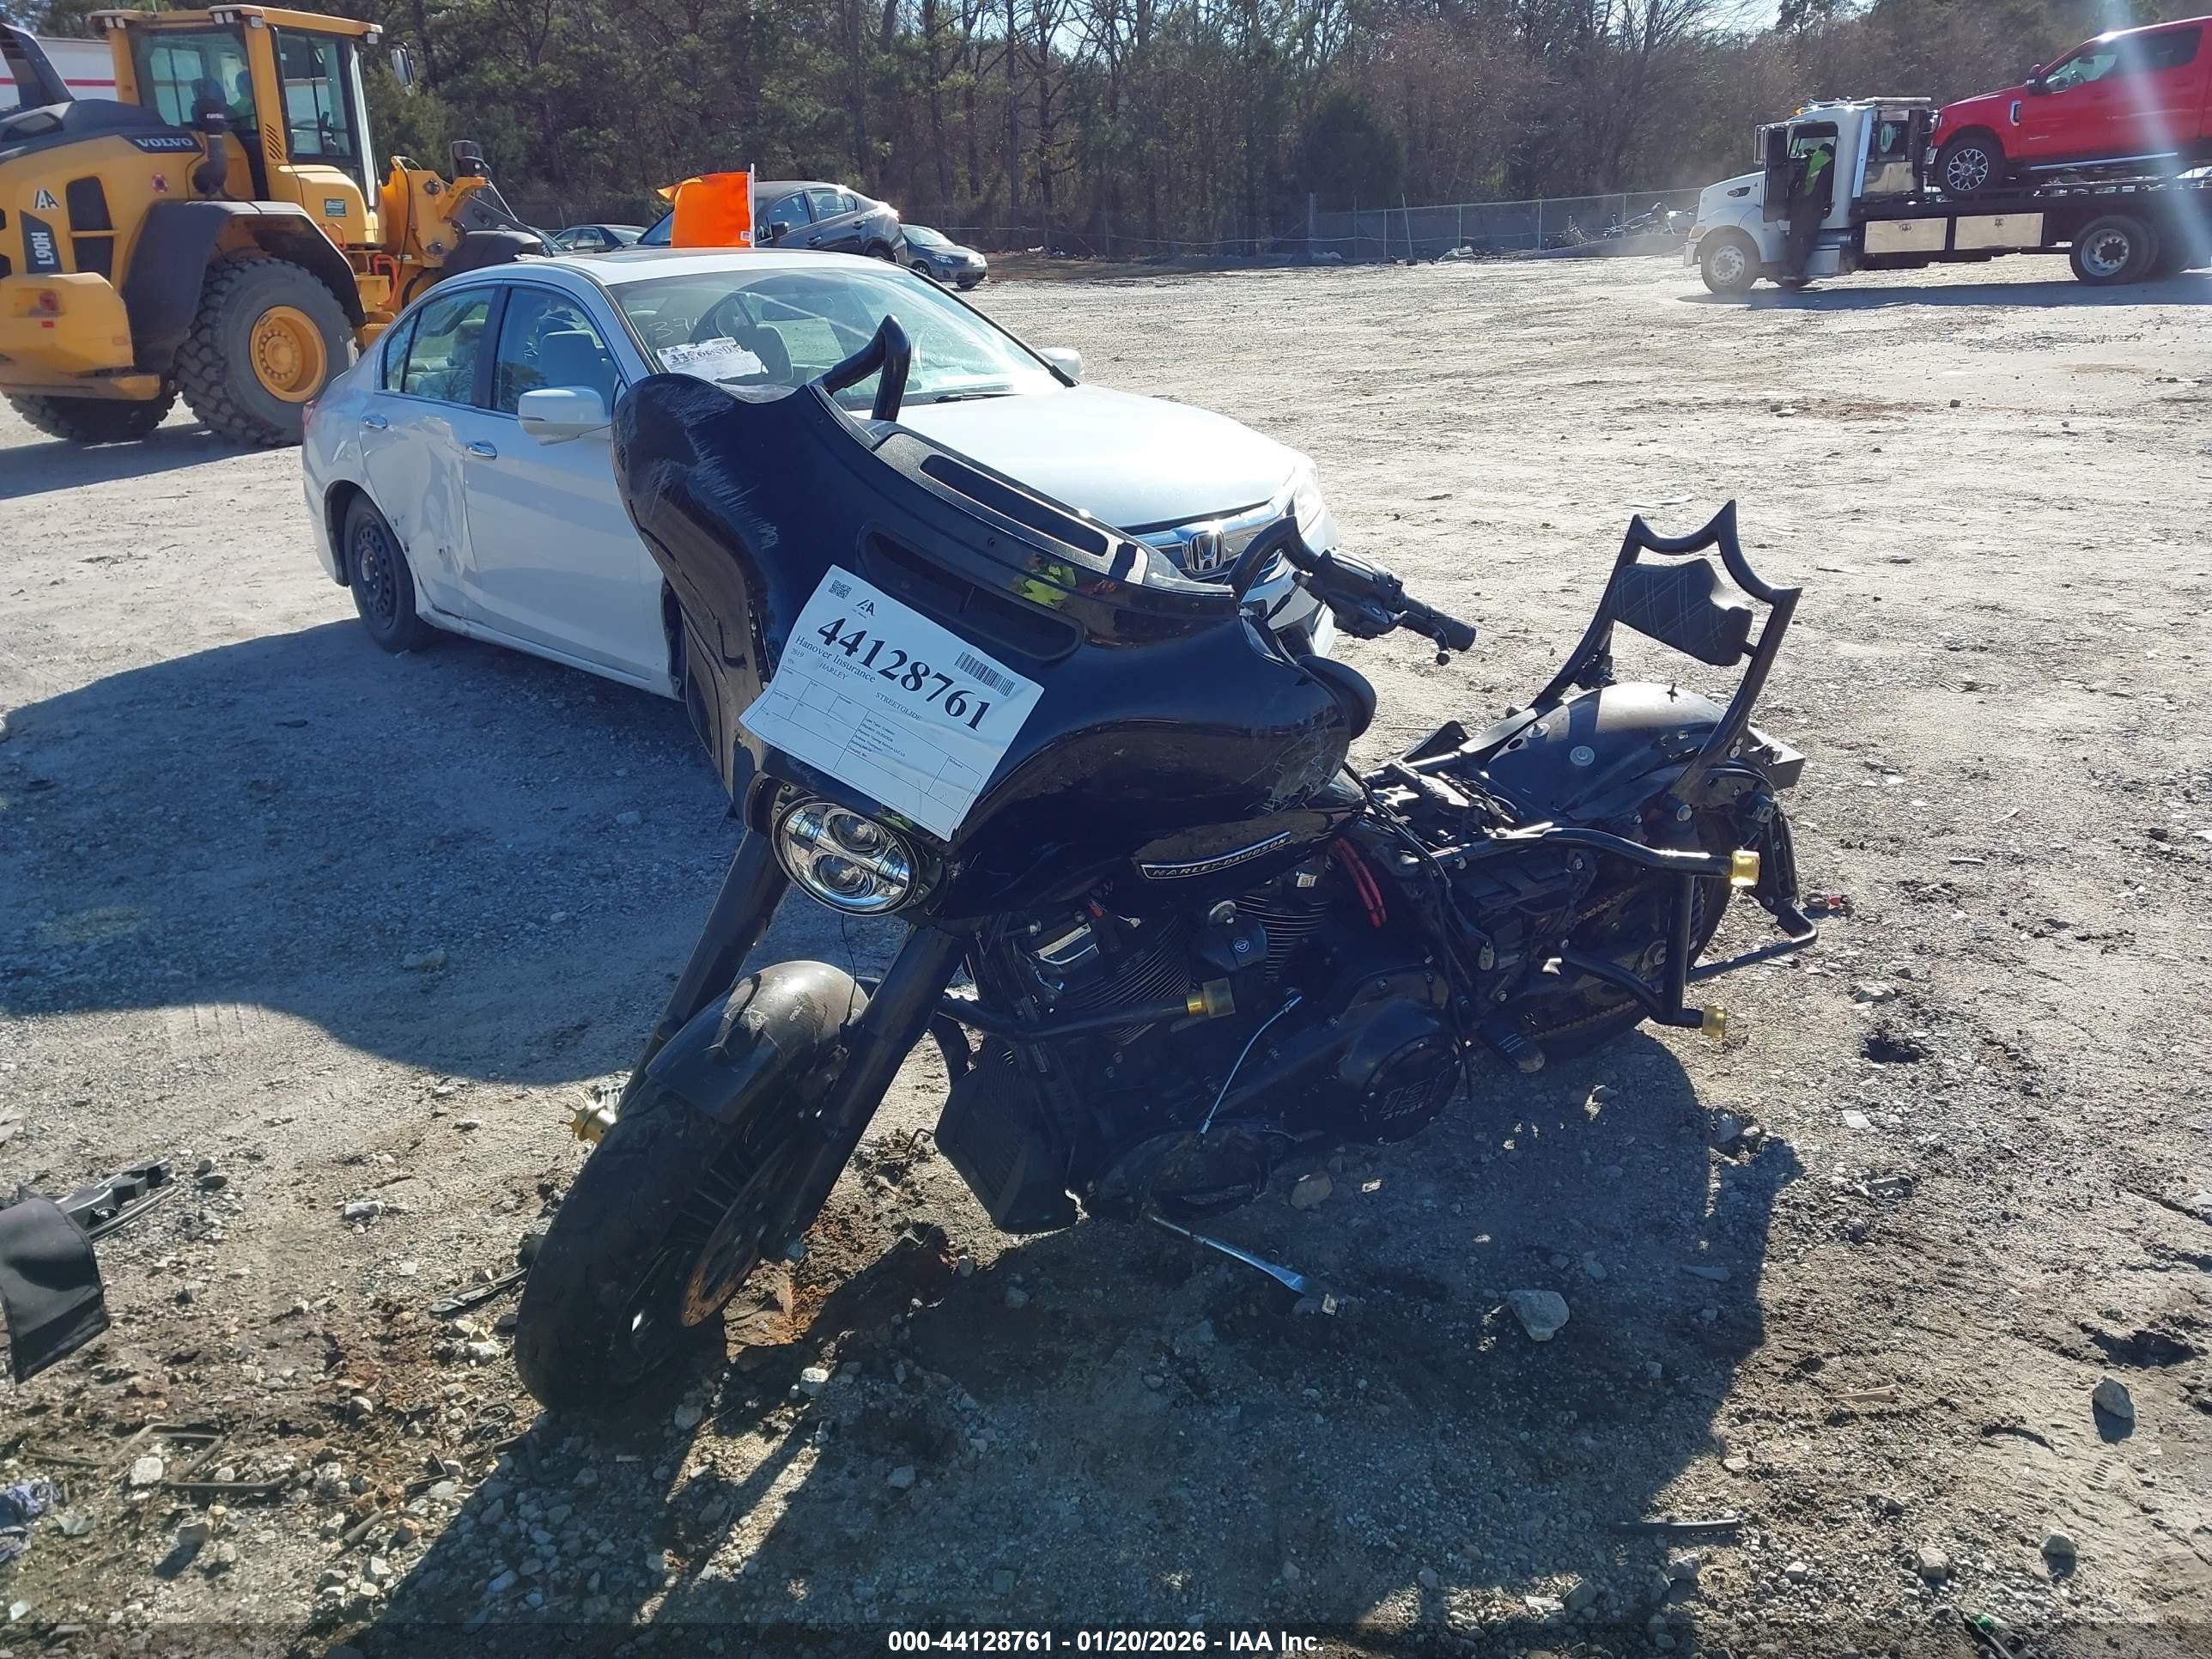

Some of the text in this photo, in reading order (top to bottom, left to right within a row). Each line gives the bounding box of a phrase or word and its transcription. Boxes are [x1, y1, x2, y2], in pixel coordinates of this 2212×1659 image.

[136, 137, 194, 148] VOLVO
[30, 232, 55, 265] L90H
[794, 635, 877, 684] Hanover Insurance
[817, 617, 991, 732] 44128761
[817, 661, 848, 681] HARLEY
[875, 692, 922, 721] STREETGLIDE
[1152, 837, 1287, 877] HARLEY-DAVIDSON
